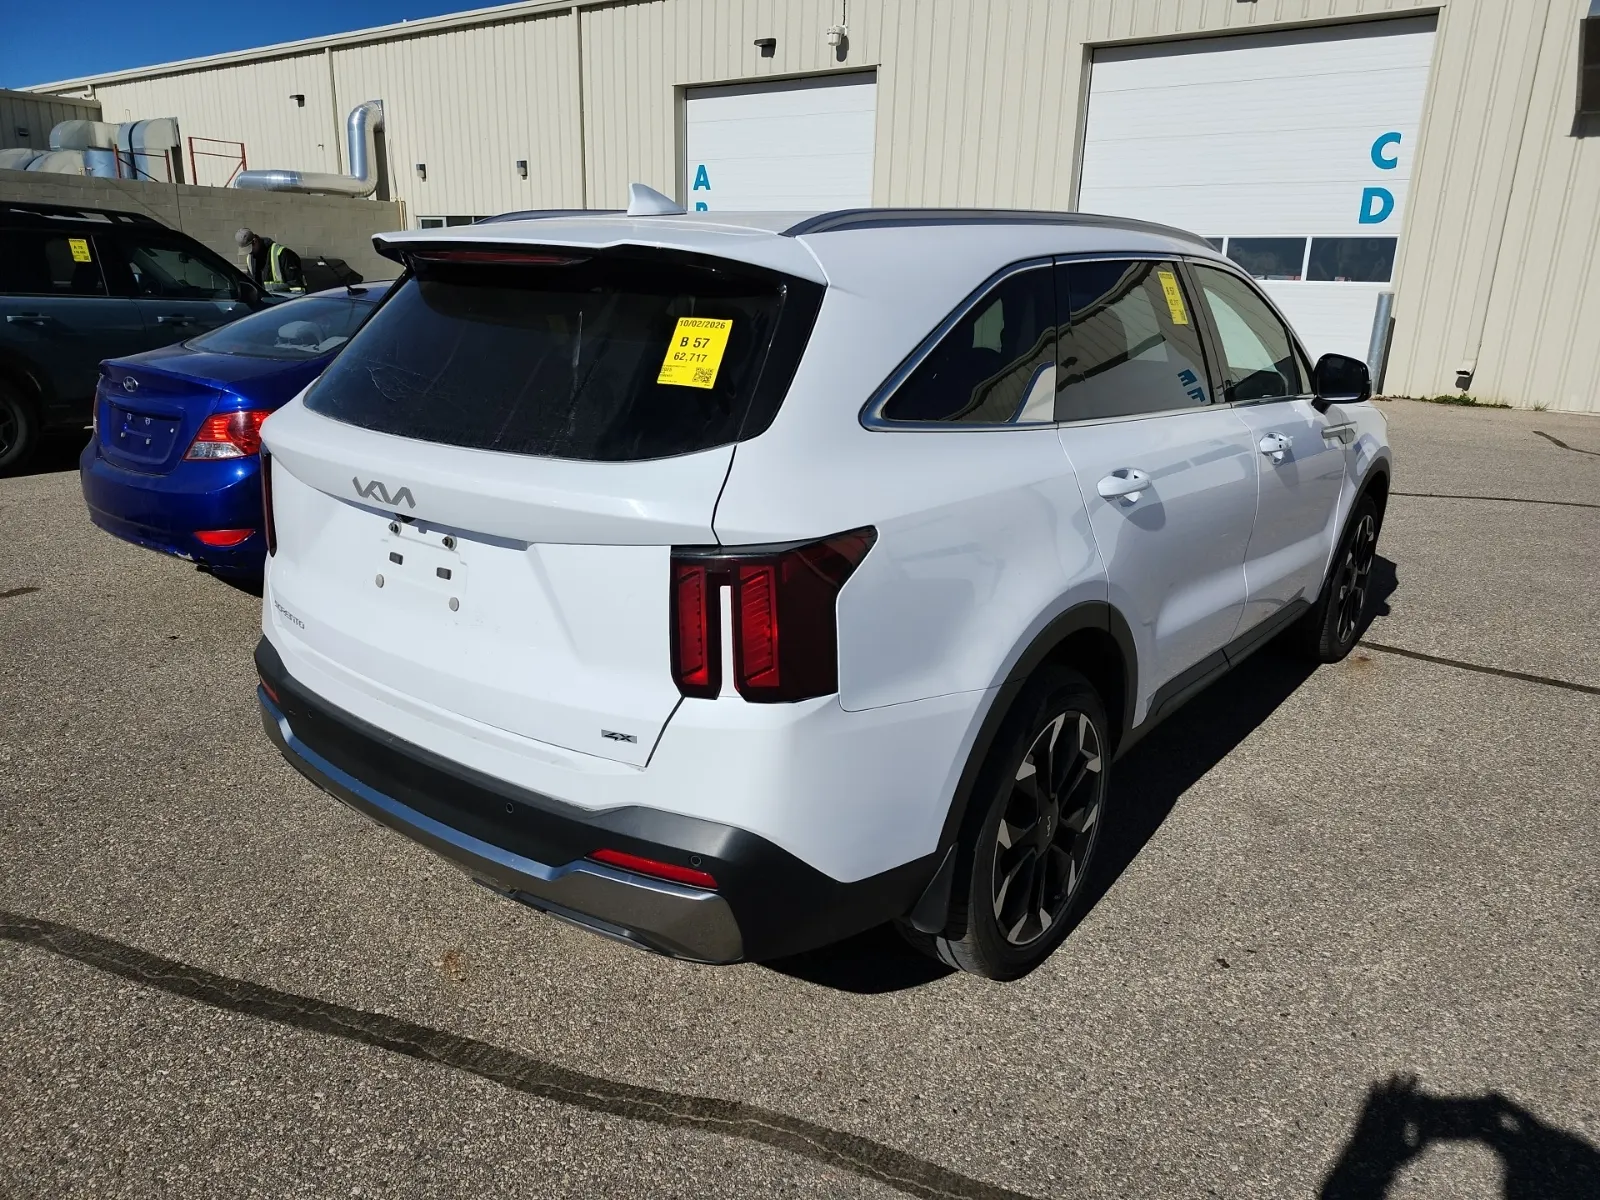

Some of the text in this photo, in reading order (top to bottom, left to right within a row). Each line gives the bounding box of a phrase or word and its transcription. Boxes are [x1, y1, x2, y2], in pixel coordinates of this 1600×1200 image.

[1371, 131, 1402, 170] C
[693, 164, 711, 190] A
[1359, 187, 1395, 224] D
[679, 319, 726, 329] 10/02/2026
[680, 336, 710, 348] B 57
[673, 352, 708, 363] 62,717
[352, 476, 416, 509] KIA
